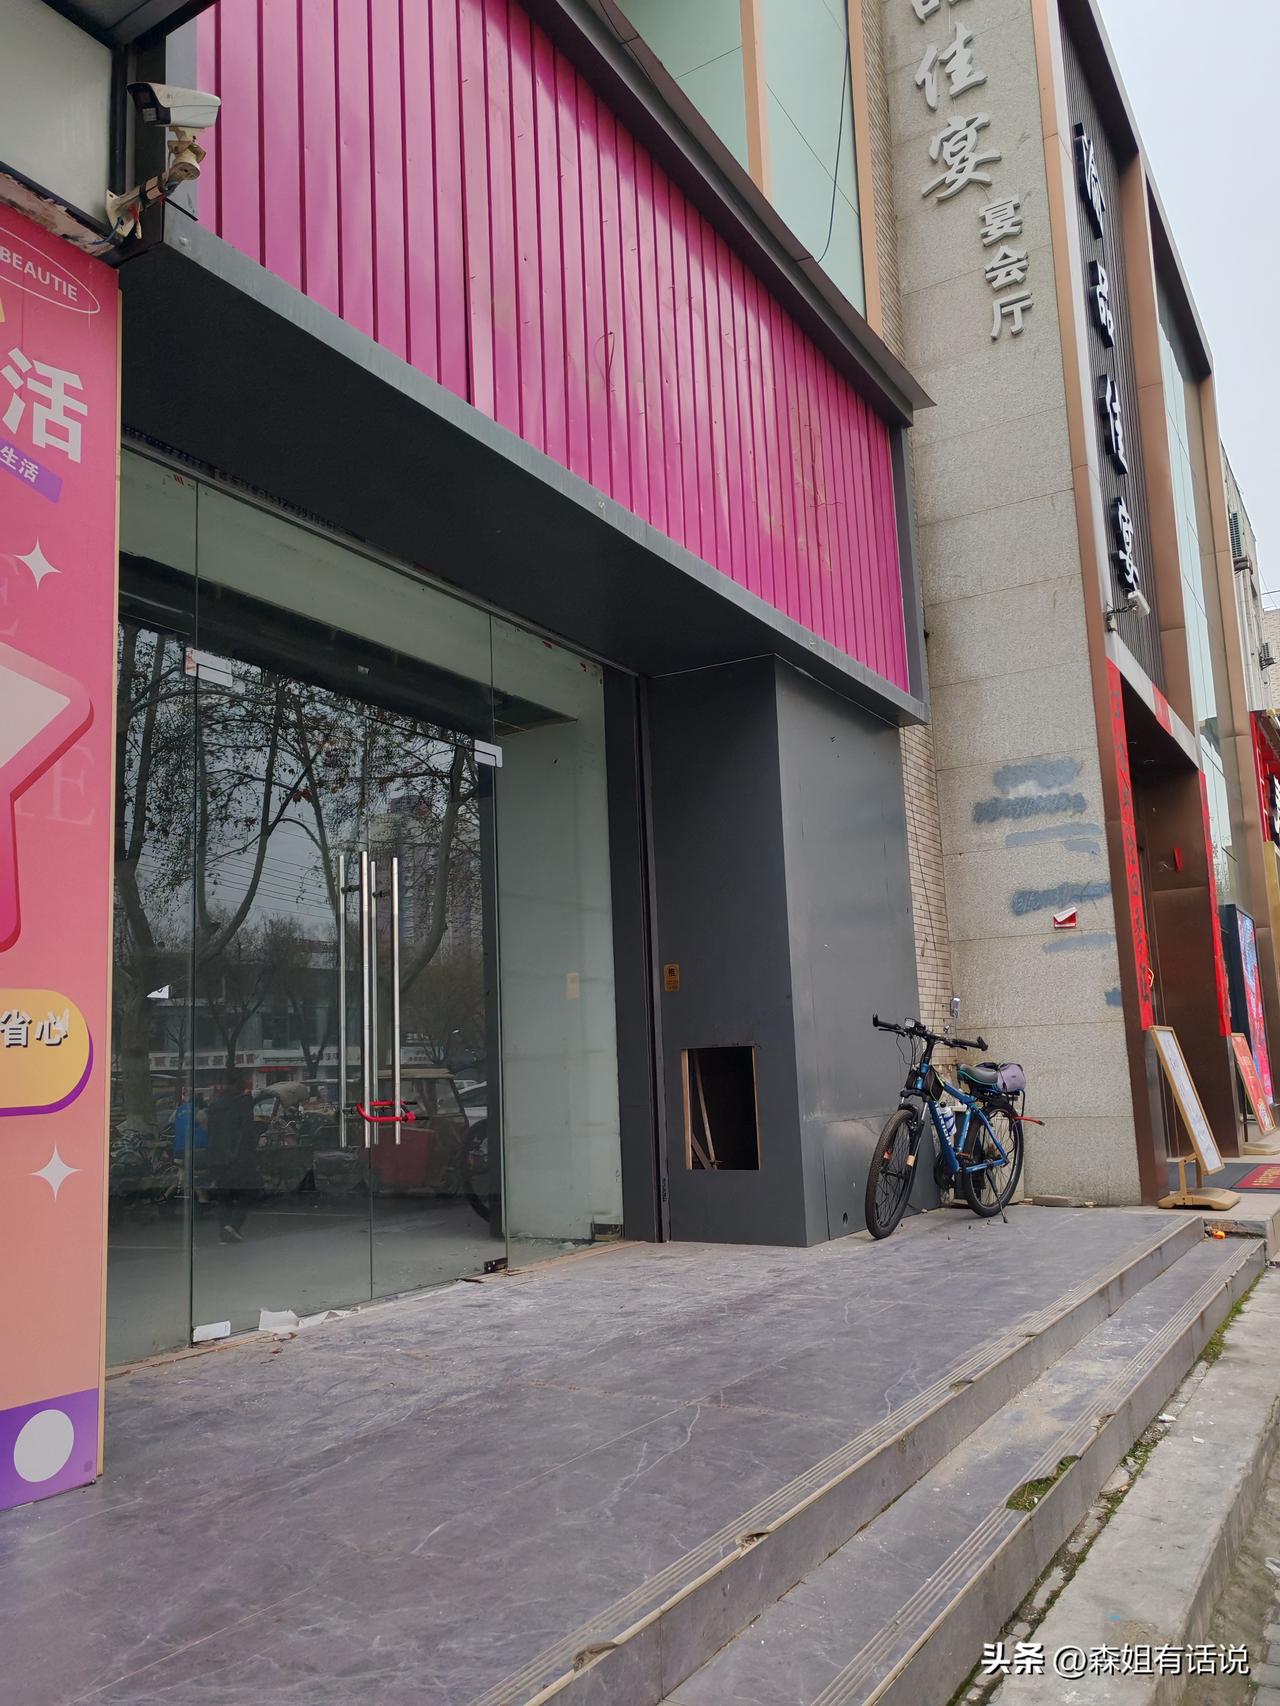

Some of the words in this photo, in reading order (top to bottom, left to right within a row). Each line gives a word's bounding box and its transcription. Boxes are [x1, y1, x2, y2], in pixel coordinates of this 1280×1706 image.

[911, 0, 1002, 200] 佳宴
[0, 245, 78, 302] BEAUTIE
[979, 197, 1034, 341] 宴会厅
[1, 347, 88, 463] 活
[0, 446, 39, 482] 生活
[0, 1008, 69, 1048] 省心
